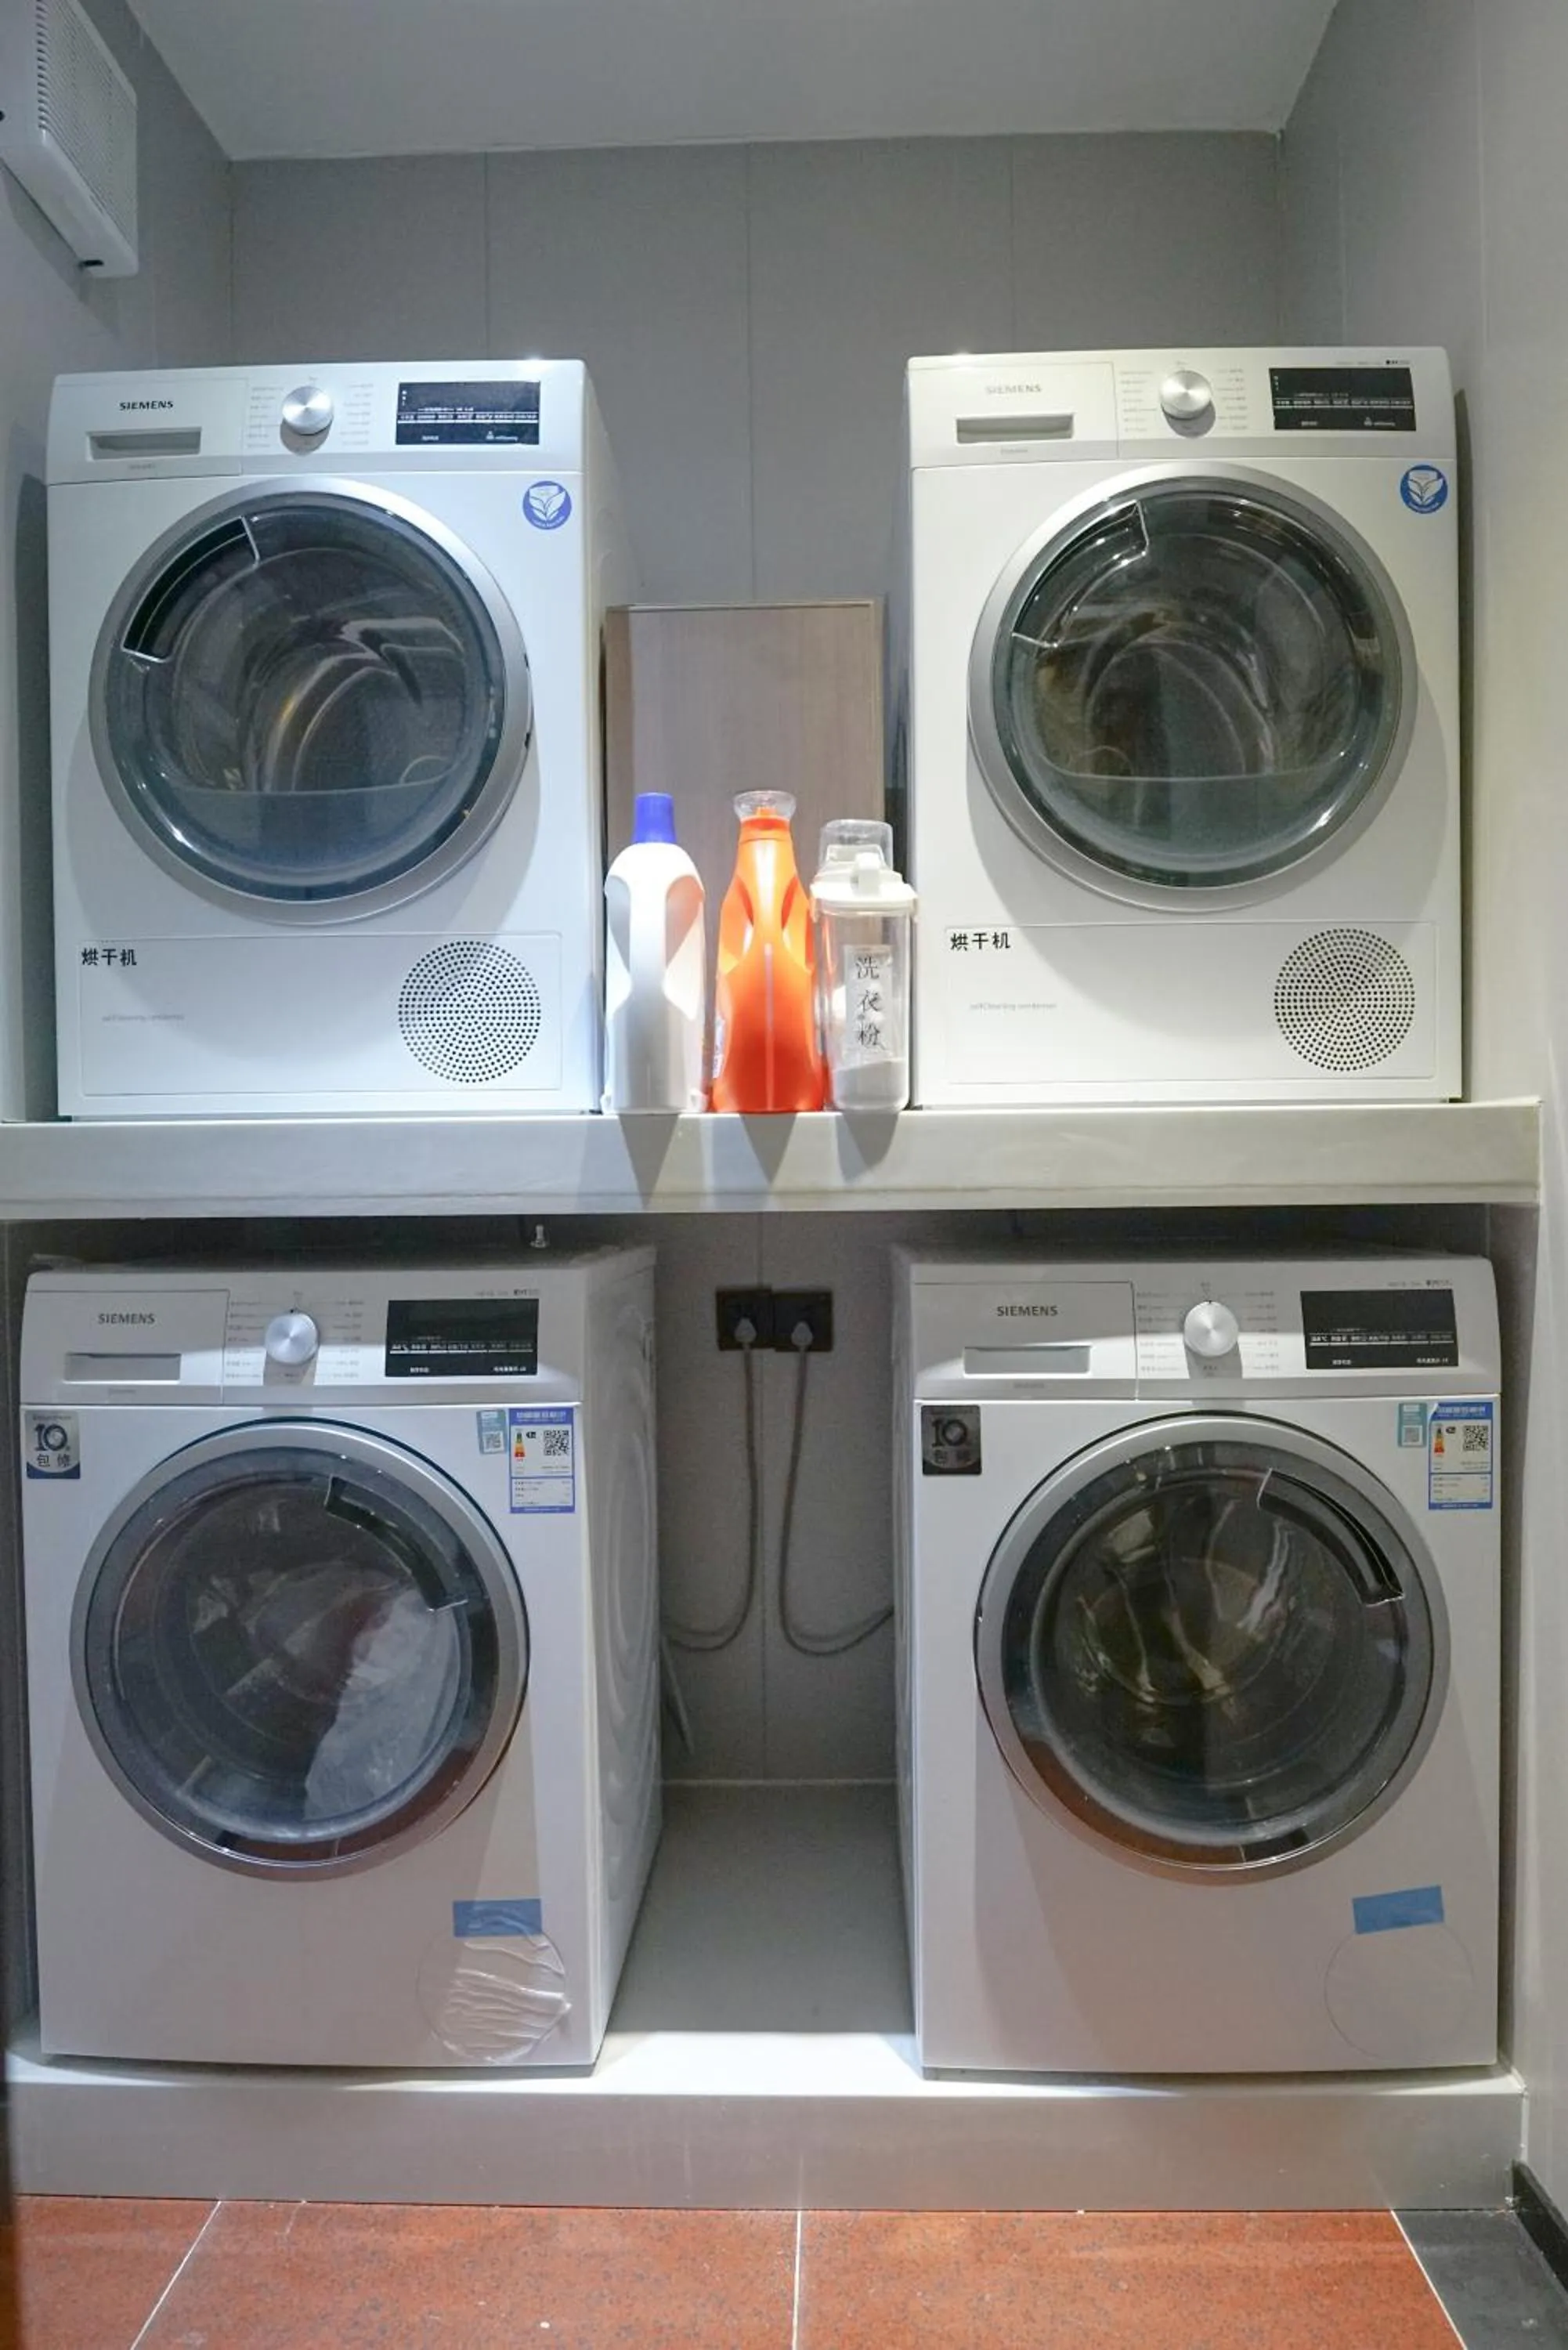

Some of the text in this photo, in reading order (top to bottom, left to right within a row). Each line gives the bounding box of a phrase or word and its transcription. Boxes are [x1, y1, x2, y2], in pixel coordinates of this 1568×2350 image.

[985, 385, 1042, 394] SIEMENS
[119, 400, 174, 410] SIEMENS
[950, 932, 1011, 951] 烘干机
[81, 949, 138, 967] 烘干机
[997, 1306, 1058, 1317] SIEMENS
[98, 1313, 155, 1325] SIEMENS
